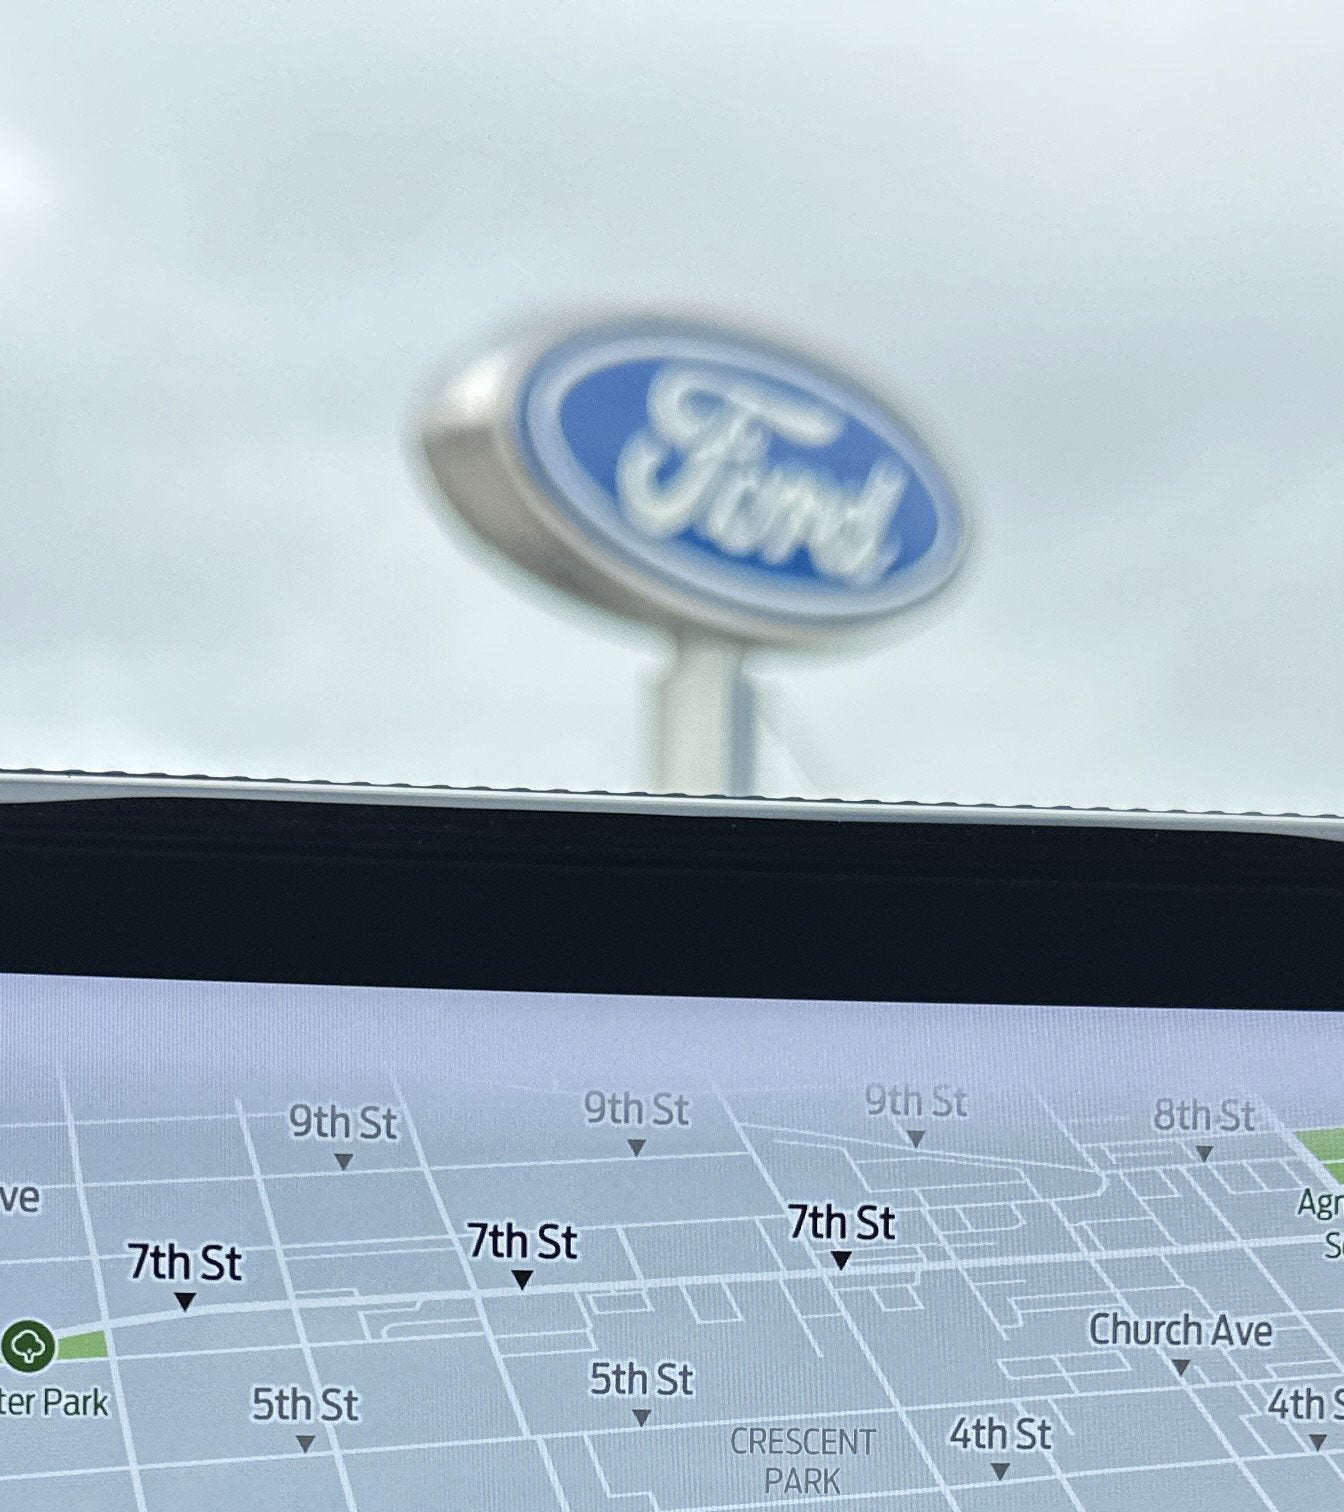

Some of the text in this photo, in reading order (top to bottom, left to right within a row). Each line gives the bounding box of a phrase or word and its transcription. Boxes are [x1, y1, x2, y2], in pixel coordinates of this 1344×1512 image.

[614, 367, 908, 586] Ford
[584, 1089, 690, 1127] 9th St
[864, 1082, 968, 1118] 9th St
[1154, 1098, 1256, 1132] 8th St
[288, 1103, 398, 1141] 9th St
[788, 1203, 896, 1241] 7th St
[467, 1222, 577, 1260] 7th St
[128, 1242, 242, 1282] 7th St
[1089, 1312, 1273, 1348] Church Ave
[591, 1361, 694, 1396] 5th St
[44, 1388, 109, 1418] Park
[252, 1386, 359, 1422] 5th St
[1268, 1386, 1325, 1420] 4th
[730, 1426, 877, 1456] CRESCENT
[949, 1415, 1052, 1450] 4th St
[764, 1467, 841, 1494] PARK
